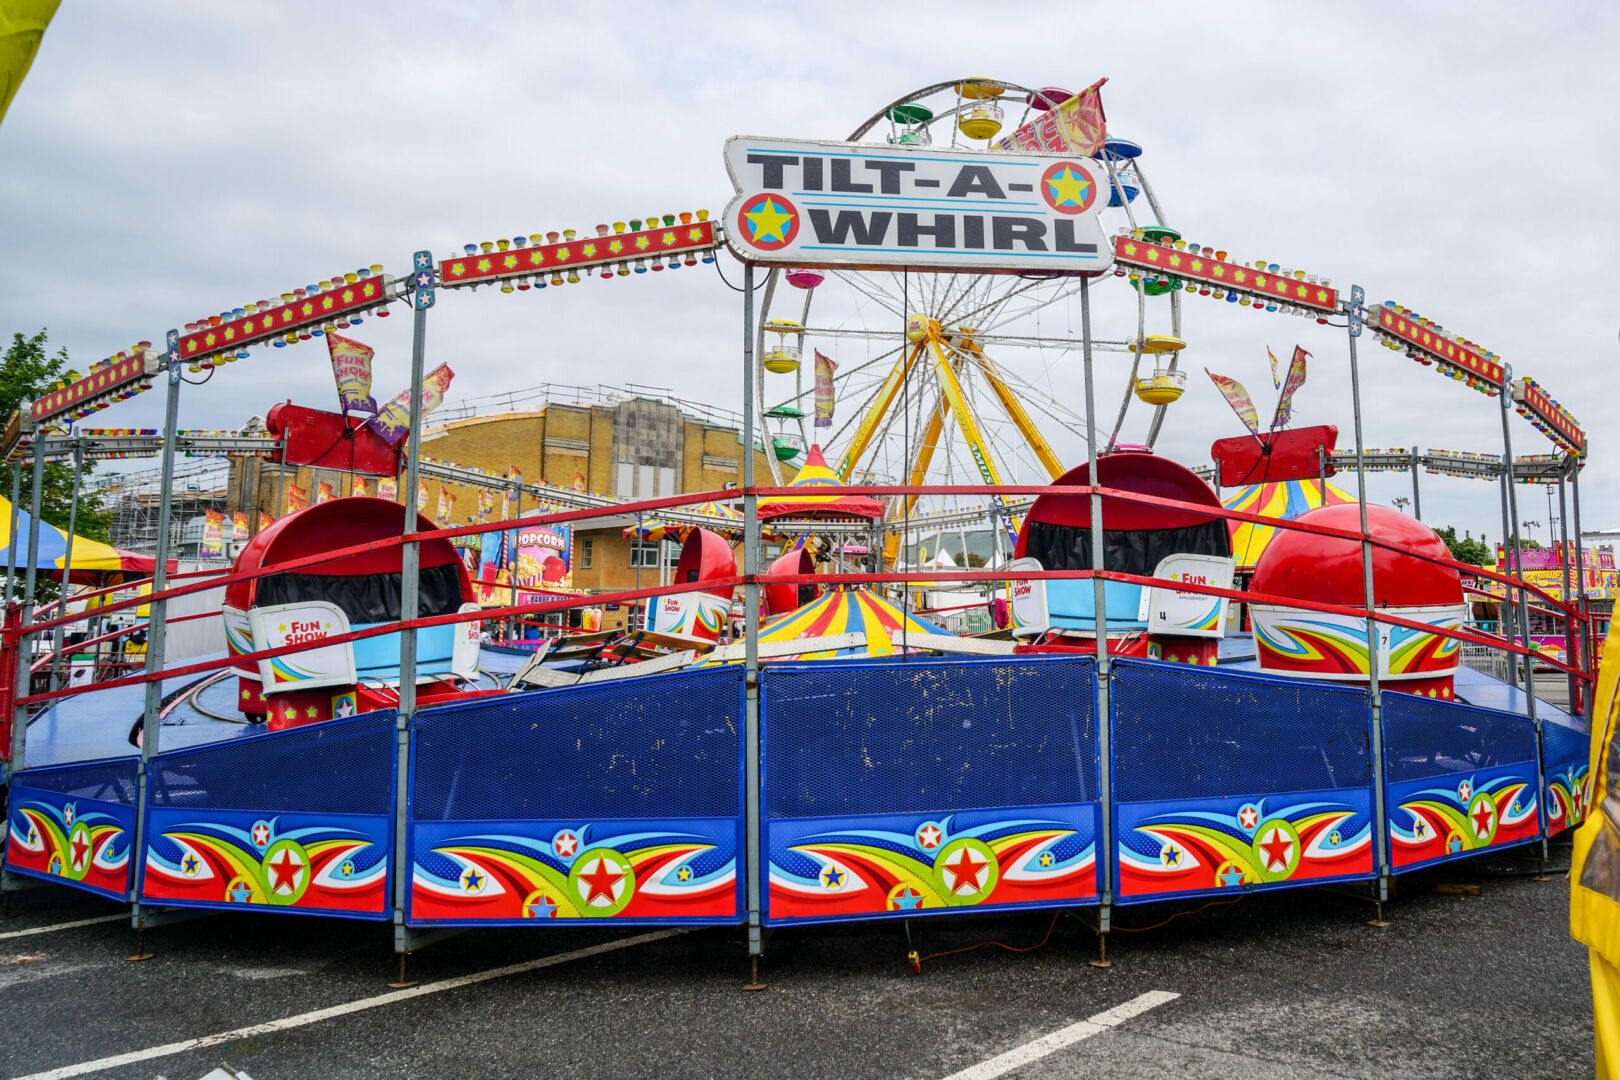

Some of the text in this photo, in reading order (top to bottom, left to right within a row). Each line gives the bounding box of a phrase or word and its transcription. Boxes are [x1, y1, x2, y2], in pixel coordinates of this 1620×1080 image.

[747, 154, 1034, 200] TILT-A-
[807, 208, 1098, 254] WHIRL
[336, 355, 364, 367] FUN
[816, 375, 832, 385] FUN
[1182, 573, 1206, 585] FUN
[1014, 585, 1032, 597] SHOW
[664, 604, 680, 612] SHOW
[667, 598, 679, 606] FUN
[1159, 611, 1167, 621] 4
[291, 620, 321, 634] FUN
[284, 631, 328, 646] SHOW
[1381, 636, 1388, 645] 7
